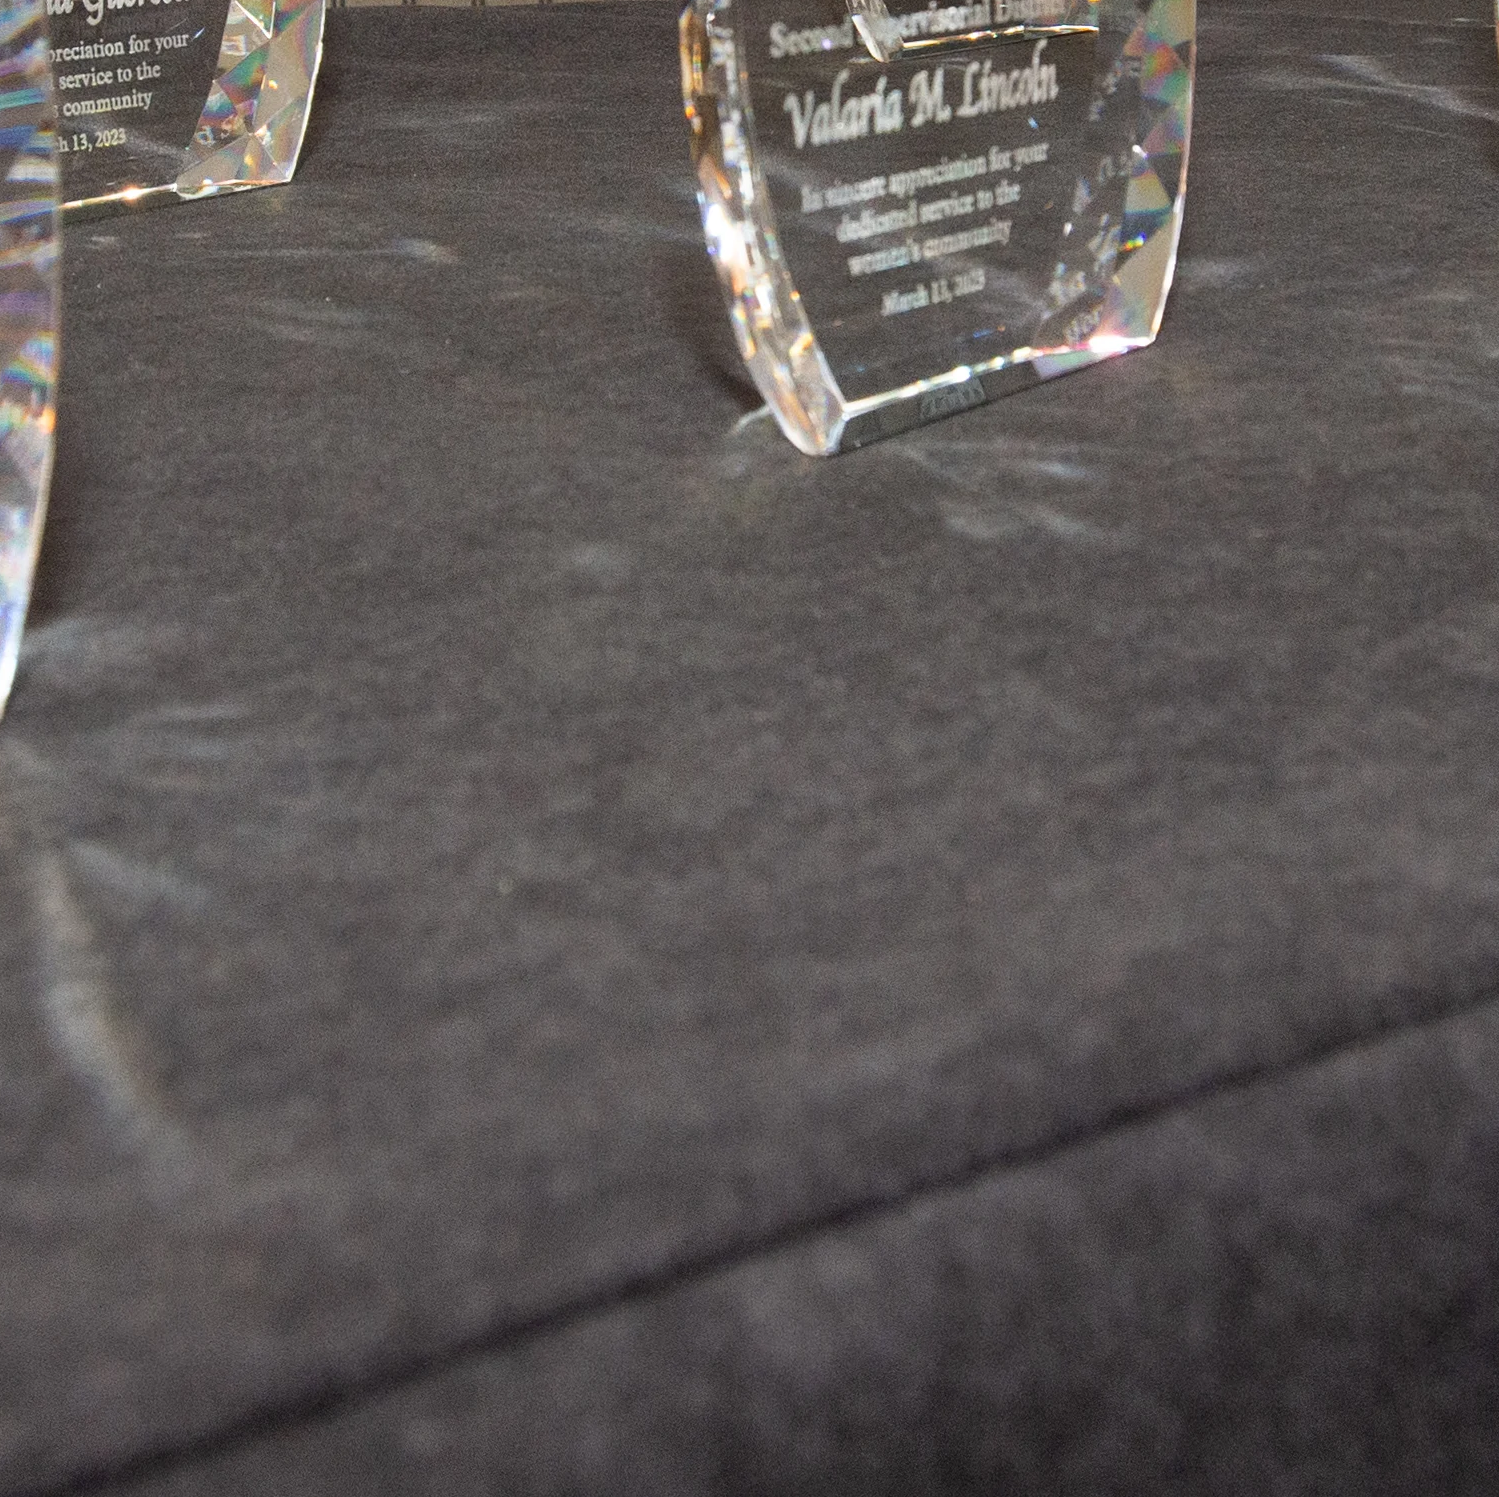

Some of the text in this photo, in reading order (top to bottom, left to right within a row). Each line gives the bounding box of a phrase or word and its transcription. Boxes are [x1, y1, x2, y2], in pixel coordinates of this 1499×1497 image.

[129, 33, 189, 54] for your
[59, 61, 161, 90] service to the
[908, 67, 952, 128] M.
[956, 38, 1059, 118] Lincoln
[63, 89, 153, 116] community
[73, 128, 126, 152] 13, 2023
[988, 145, 1012, 172] for
[994, 179, 1021, 205] the
